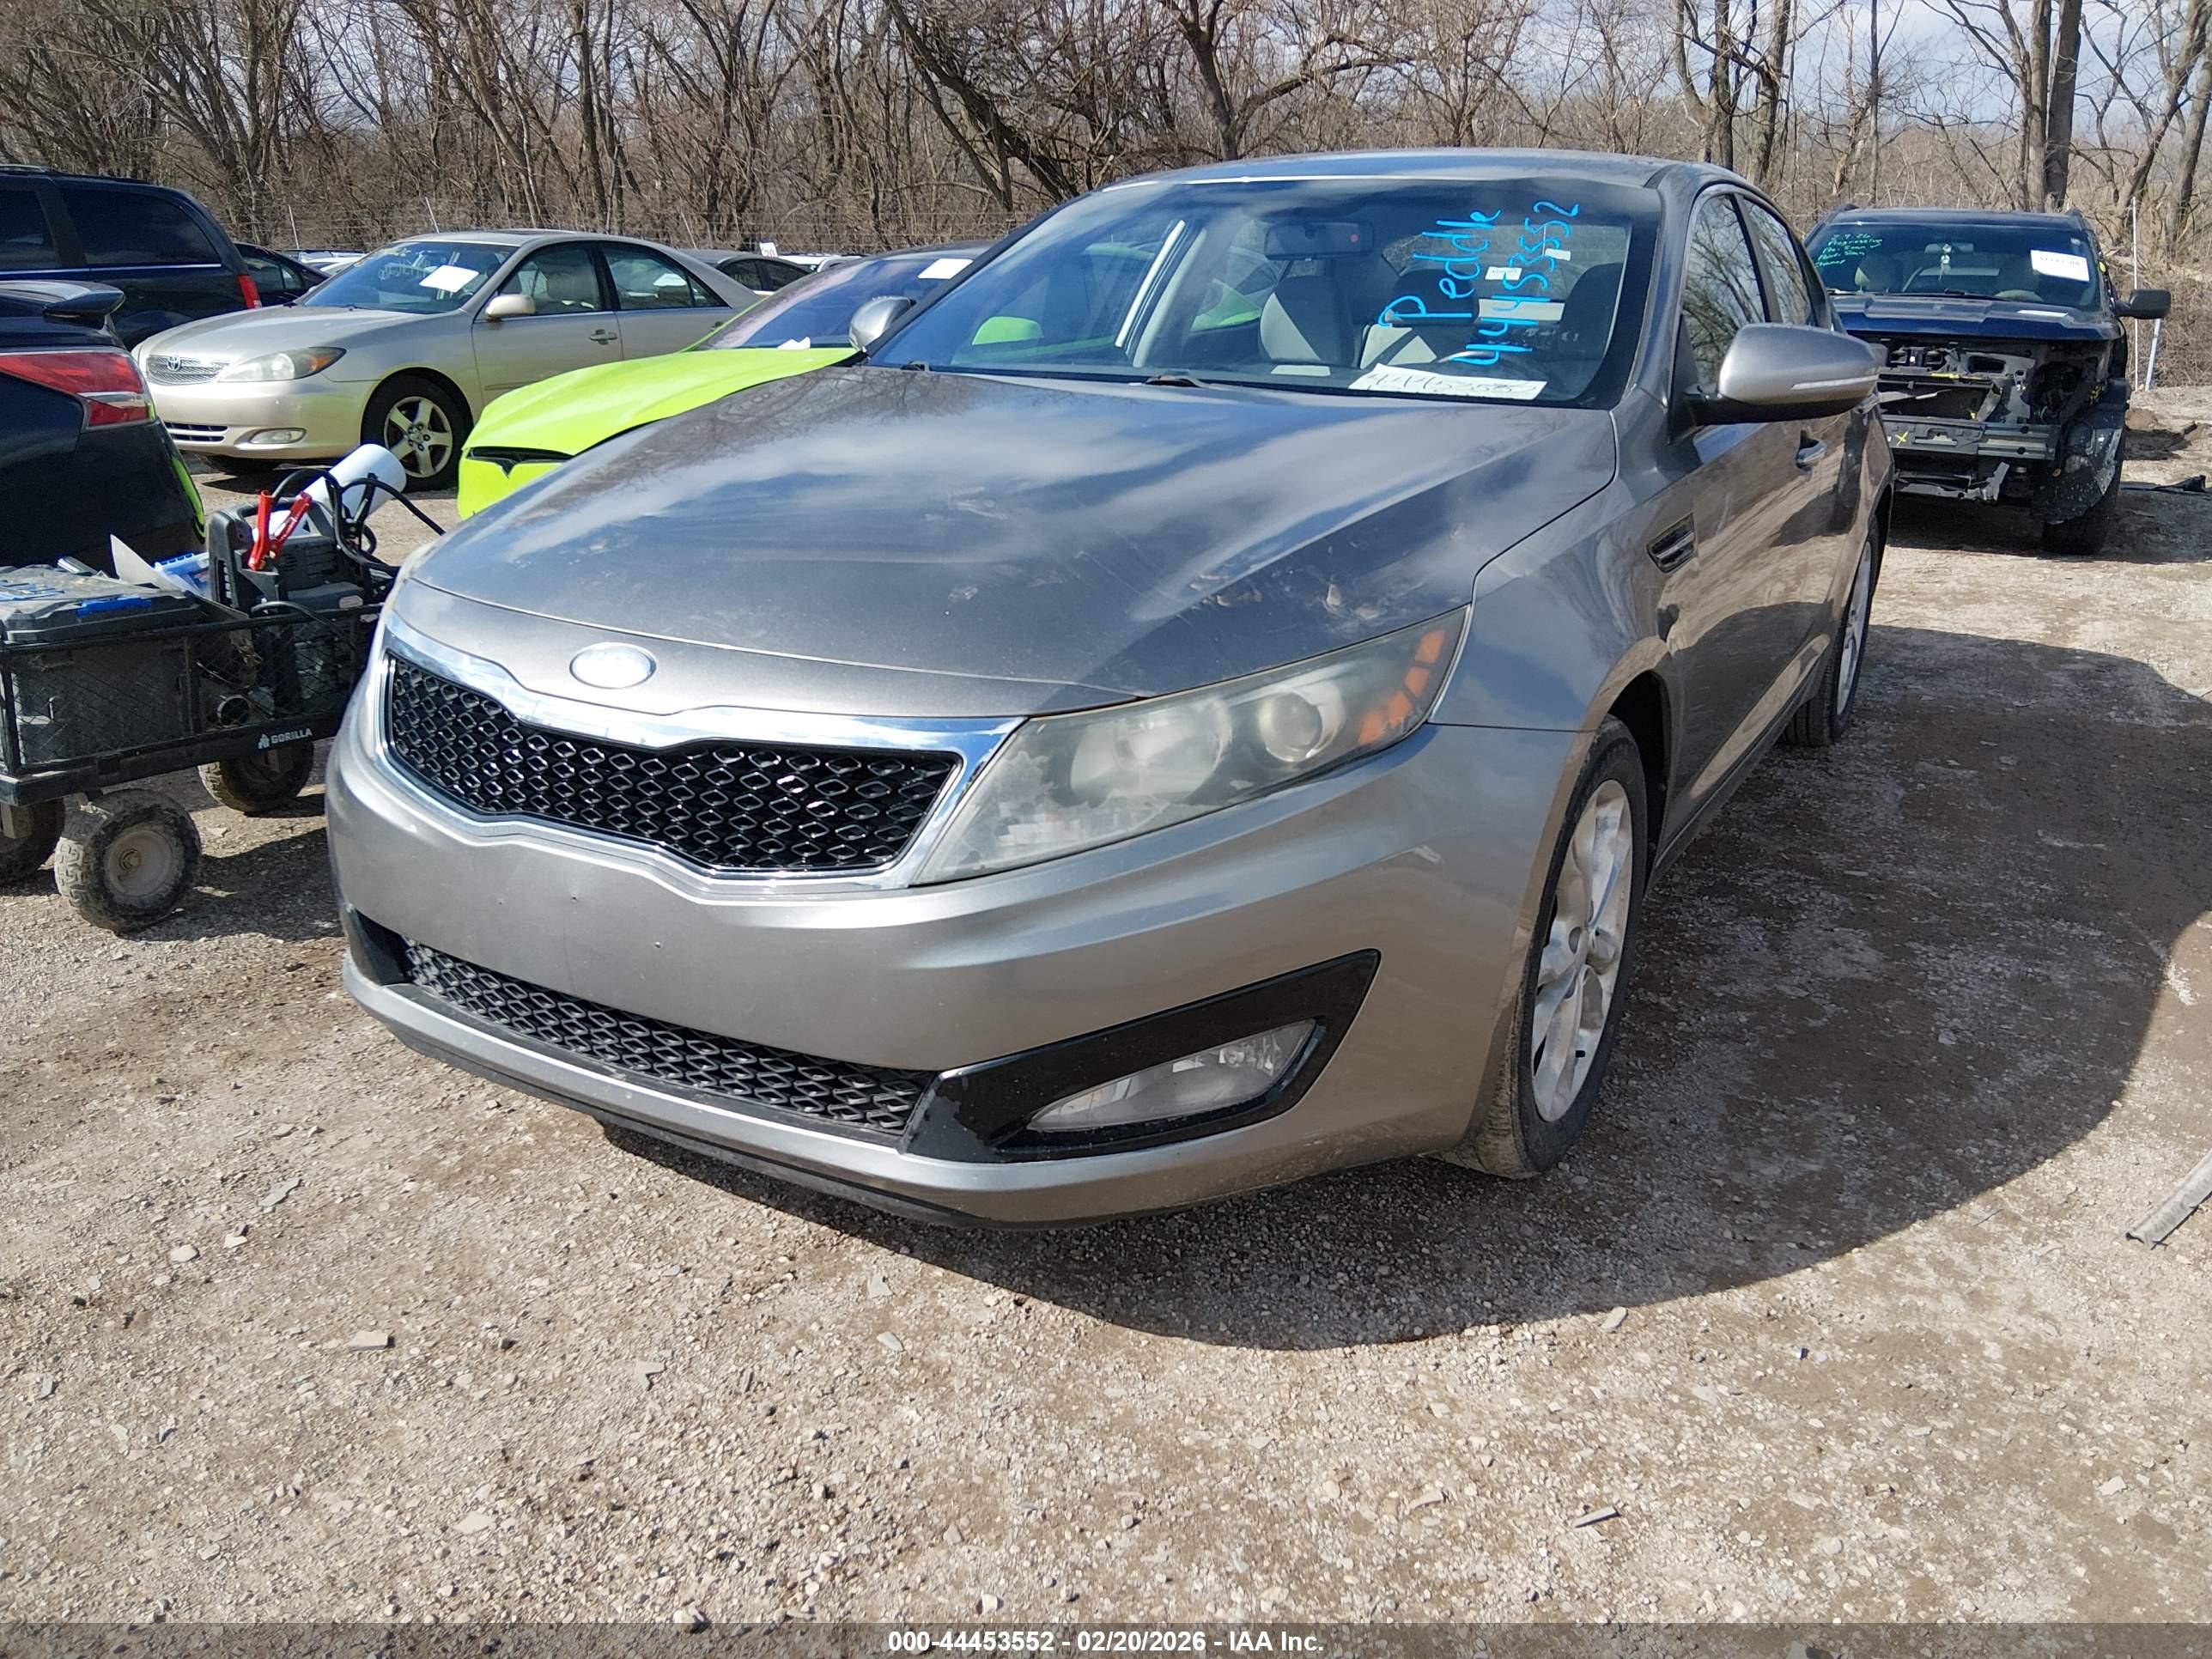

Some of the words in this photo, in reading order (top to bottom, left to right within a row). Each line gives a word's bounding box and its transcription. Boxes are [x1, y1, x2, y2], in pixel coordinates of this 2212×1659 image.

[1378, 210, 1501, 327] Peddle
[1449, 201, 1579, 365] 44453552
[270, 727, 313, 744] GORILLA
